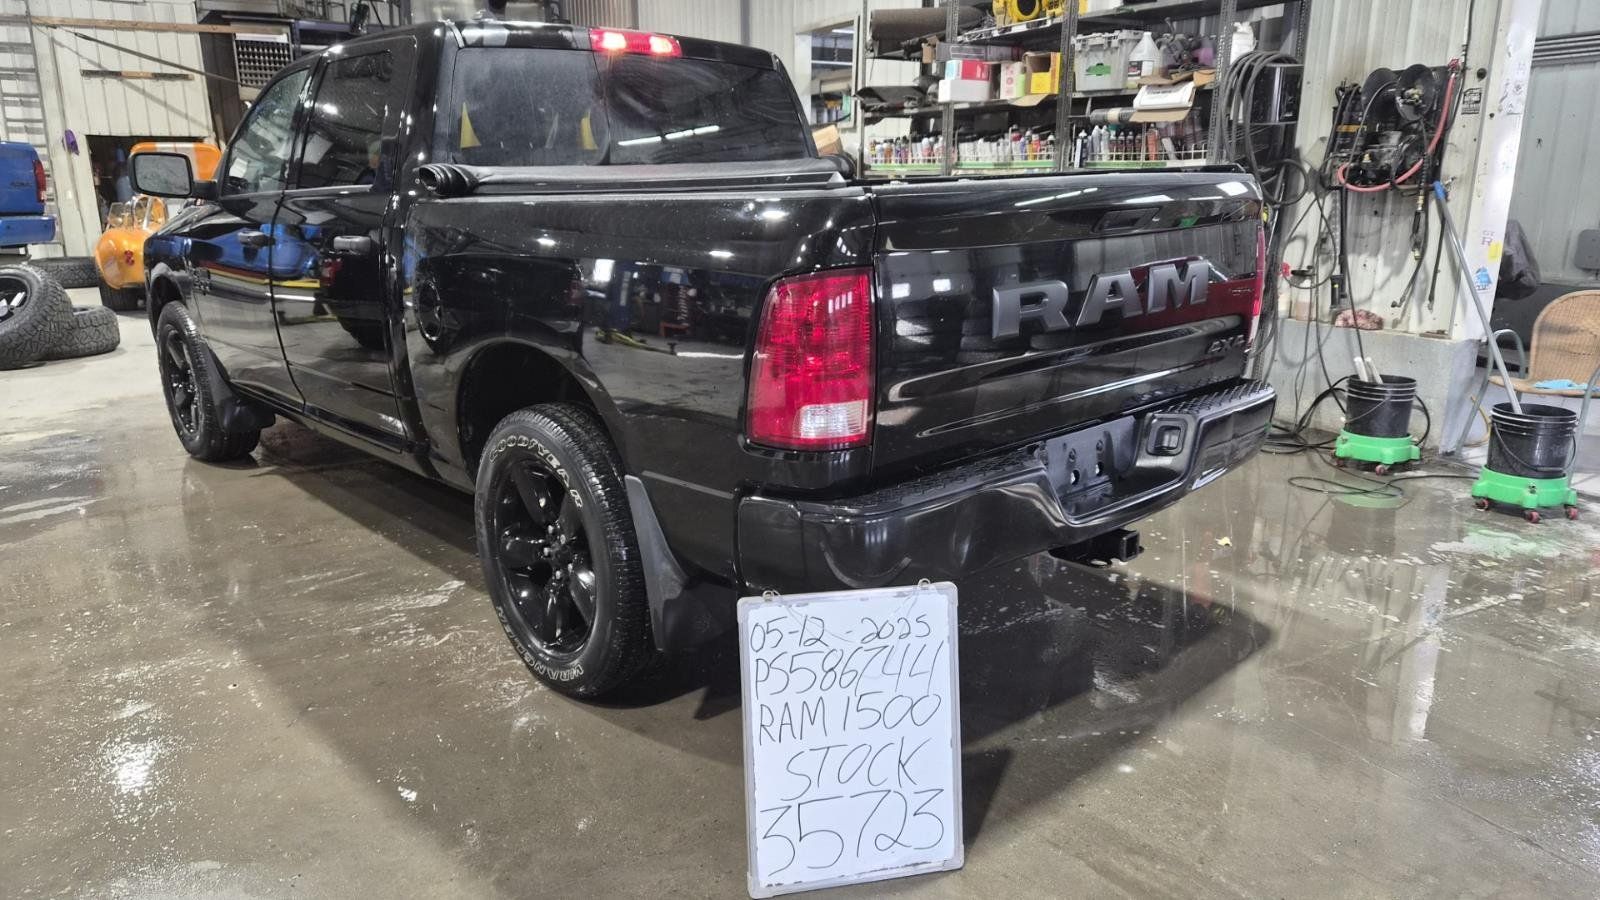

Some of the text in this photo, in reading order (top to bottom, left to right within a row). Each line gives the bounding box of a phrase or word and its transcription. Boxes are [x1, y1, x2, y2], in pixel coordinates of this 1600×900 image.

[992, 259, 1209, 339] RAM
[755, 640, 944, 700] PS586744
[760, 690, 942, 746] RAM 1500
[780, 736, 932, 801] STOCK
[760, 788, 945, 877] 35723
